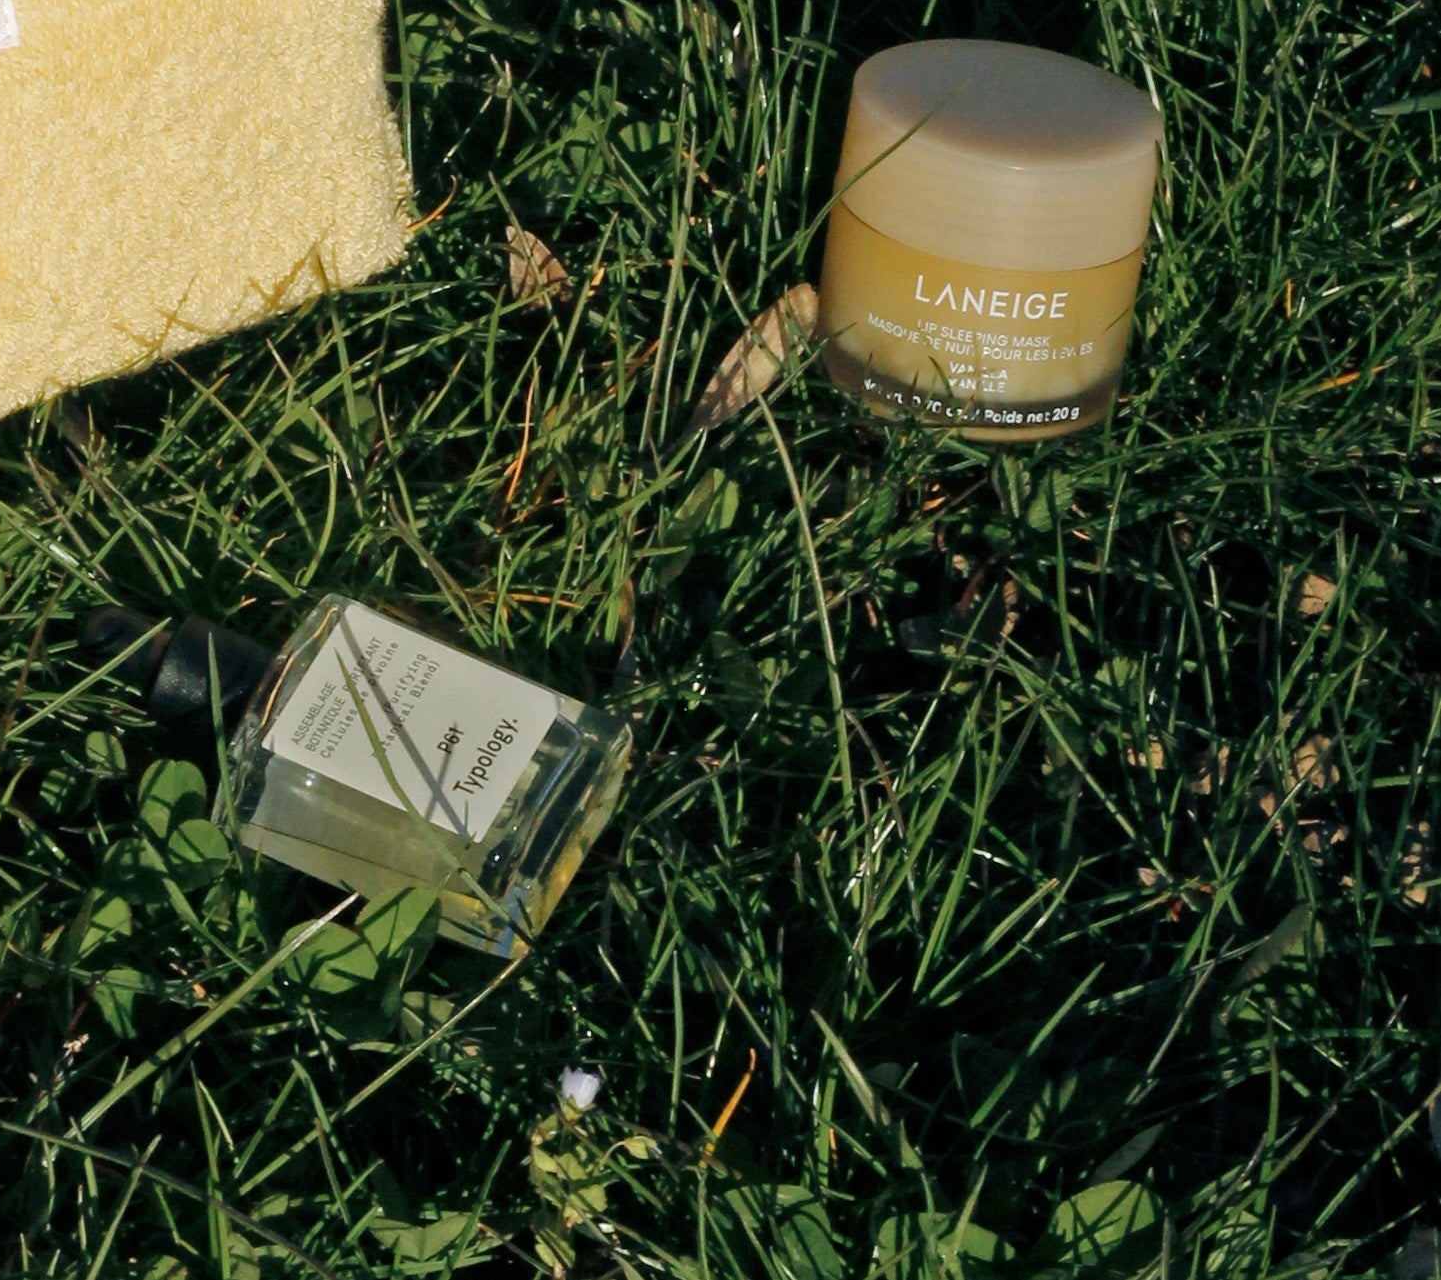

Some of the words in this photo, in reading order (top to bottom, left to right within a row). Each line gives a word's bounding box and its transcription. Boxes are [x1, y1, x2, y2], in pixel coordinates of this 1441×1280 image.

[914, 275, 1069, 320] LANEIGE
[917, 319, 937, 334] LIP
[1012, 335, 1052, 348] MASK
[982, 347, 1022, 361] POUR
[1025, 349, 1049, 361] LES
[984, 408, 1023, 424] Poids
[1052, 407, 1070, 421] 20
[1070, 407, 1080, 420] g
[410, 660, 441, 699] Blend)
[291, 682, 336, 745] ASSEMBLAGE
[305, 696, 346, 752] BOTANIQUE
[320, 708, 358, 759] Cellules
[437, 726, 465, 755] P61
[452, 717, 519, 795] Typology.
